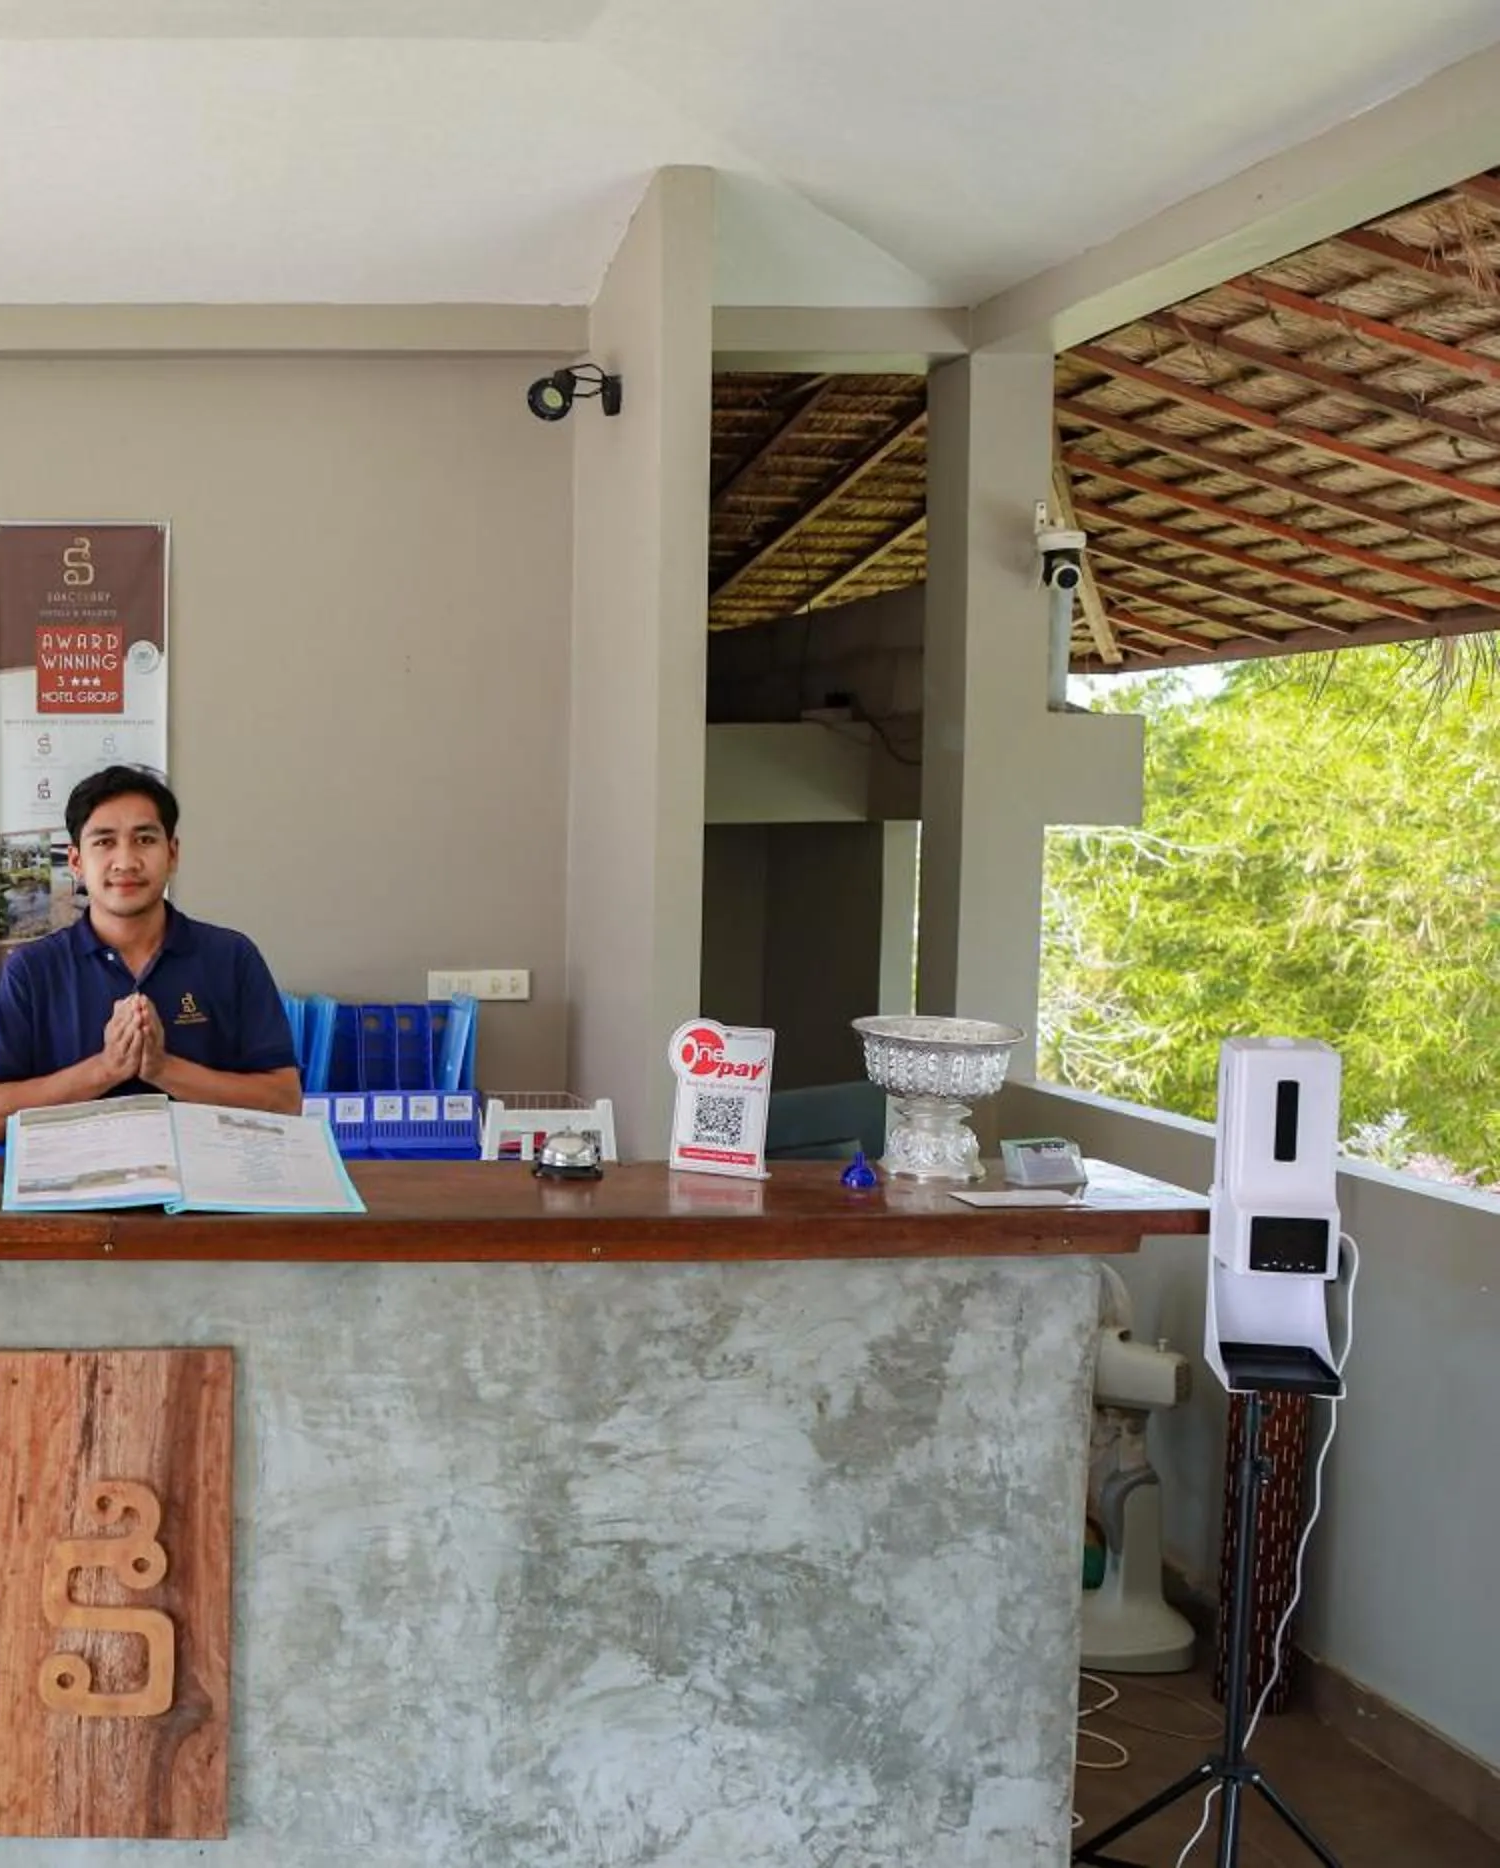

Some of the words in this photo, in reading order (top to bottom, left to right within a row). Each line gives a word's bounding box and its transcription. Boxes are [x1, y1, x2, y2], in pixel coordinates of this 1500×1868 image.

[41, 633, 119, 650] AWARD
[41, 653, 118, 671] WINNING
[41, 691, 75, 703] HOTEL
[77, 691, 119, 703] GROUP
[680, 1035, 725, 1071] One
[716, 1060, 766, 1081] pay
